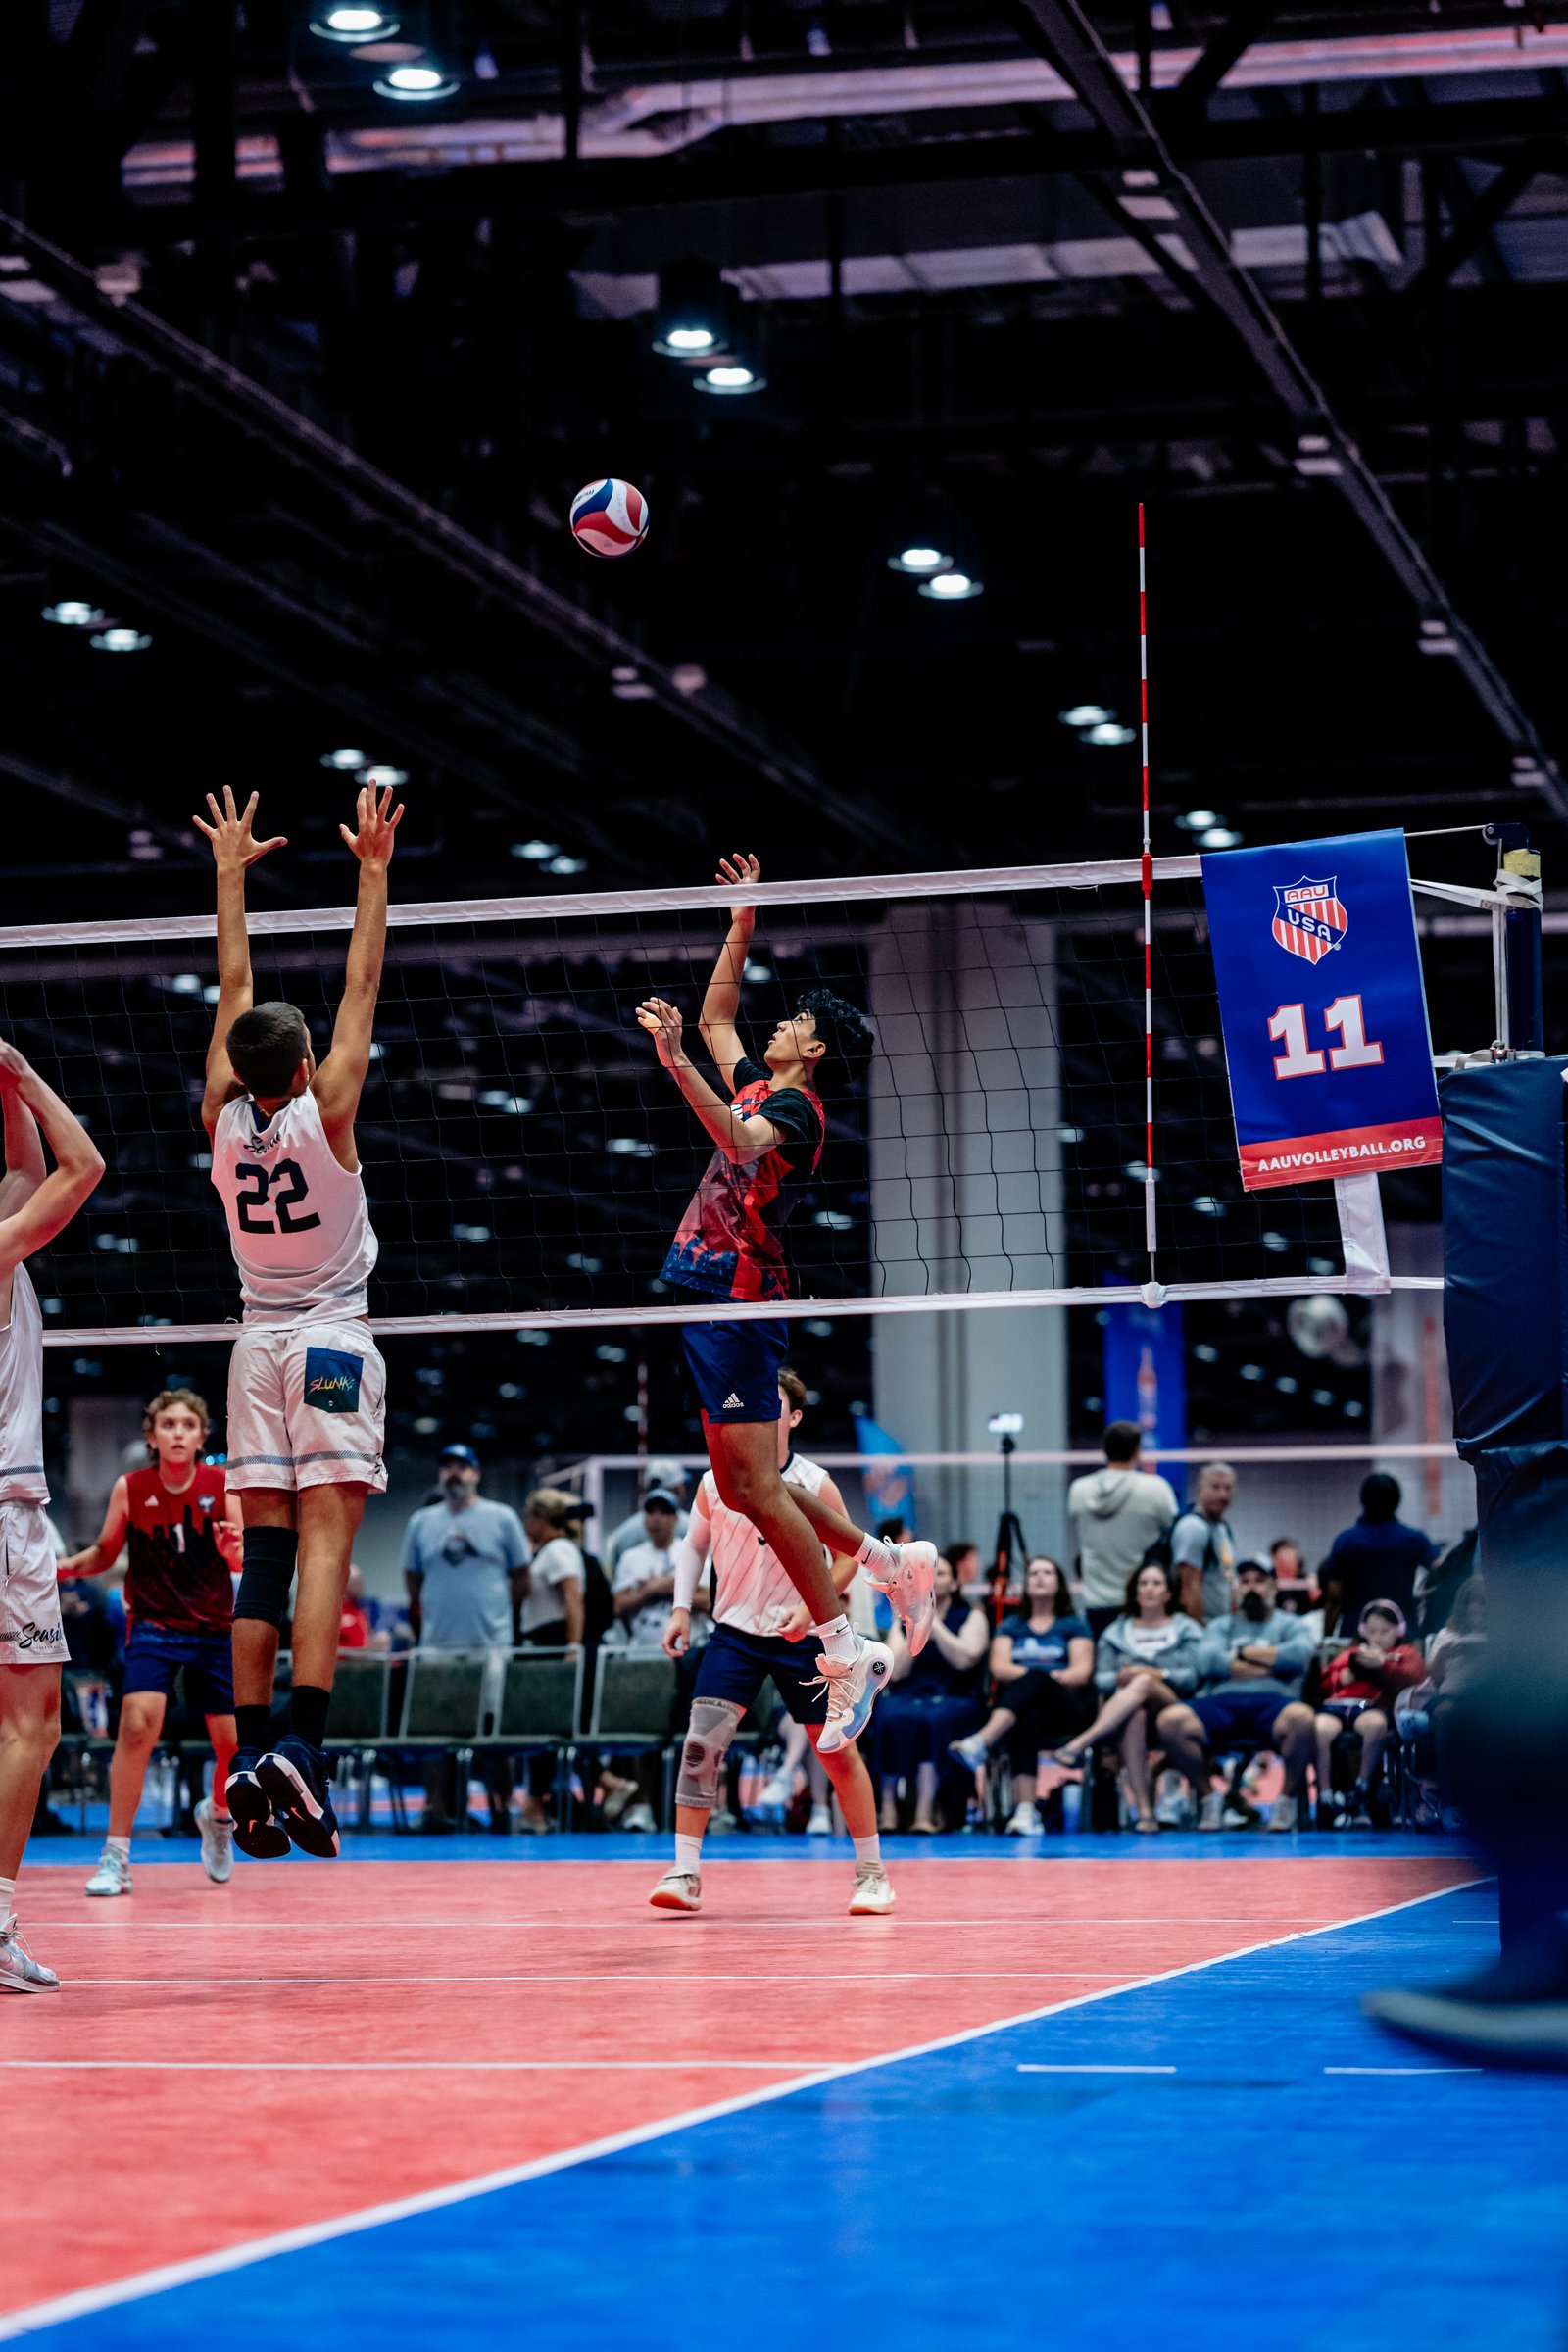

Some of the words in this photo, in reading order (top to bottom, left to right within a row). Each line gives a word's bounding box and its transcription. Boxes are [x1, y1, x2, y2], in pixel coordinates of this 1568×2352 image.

[1287, 885, 1326, 901] AAU
[1288, 907, 1331, 942] USA
[1267, 994, 1385, 1081] 11
[1258, 1136, 1426, 1172] AAUVOLLEYBALL.ORG
[235, 1158, 321, 1234] 22
[172, 1523, 186, 1554] 1
